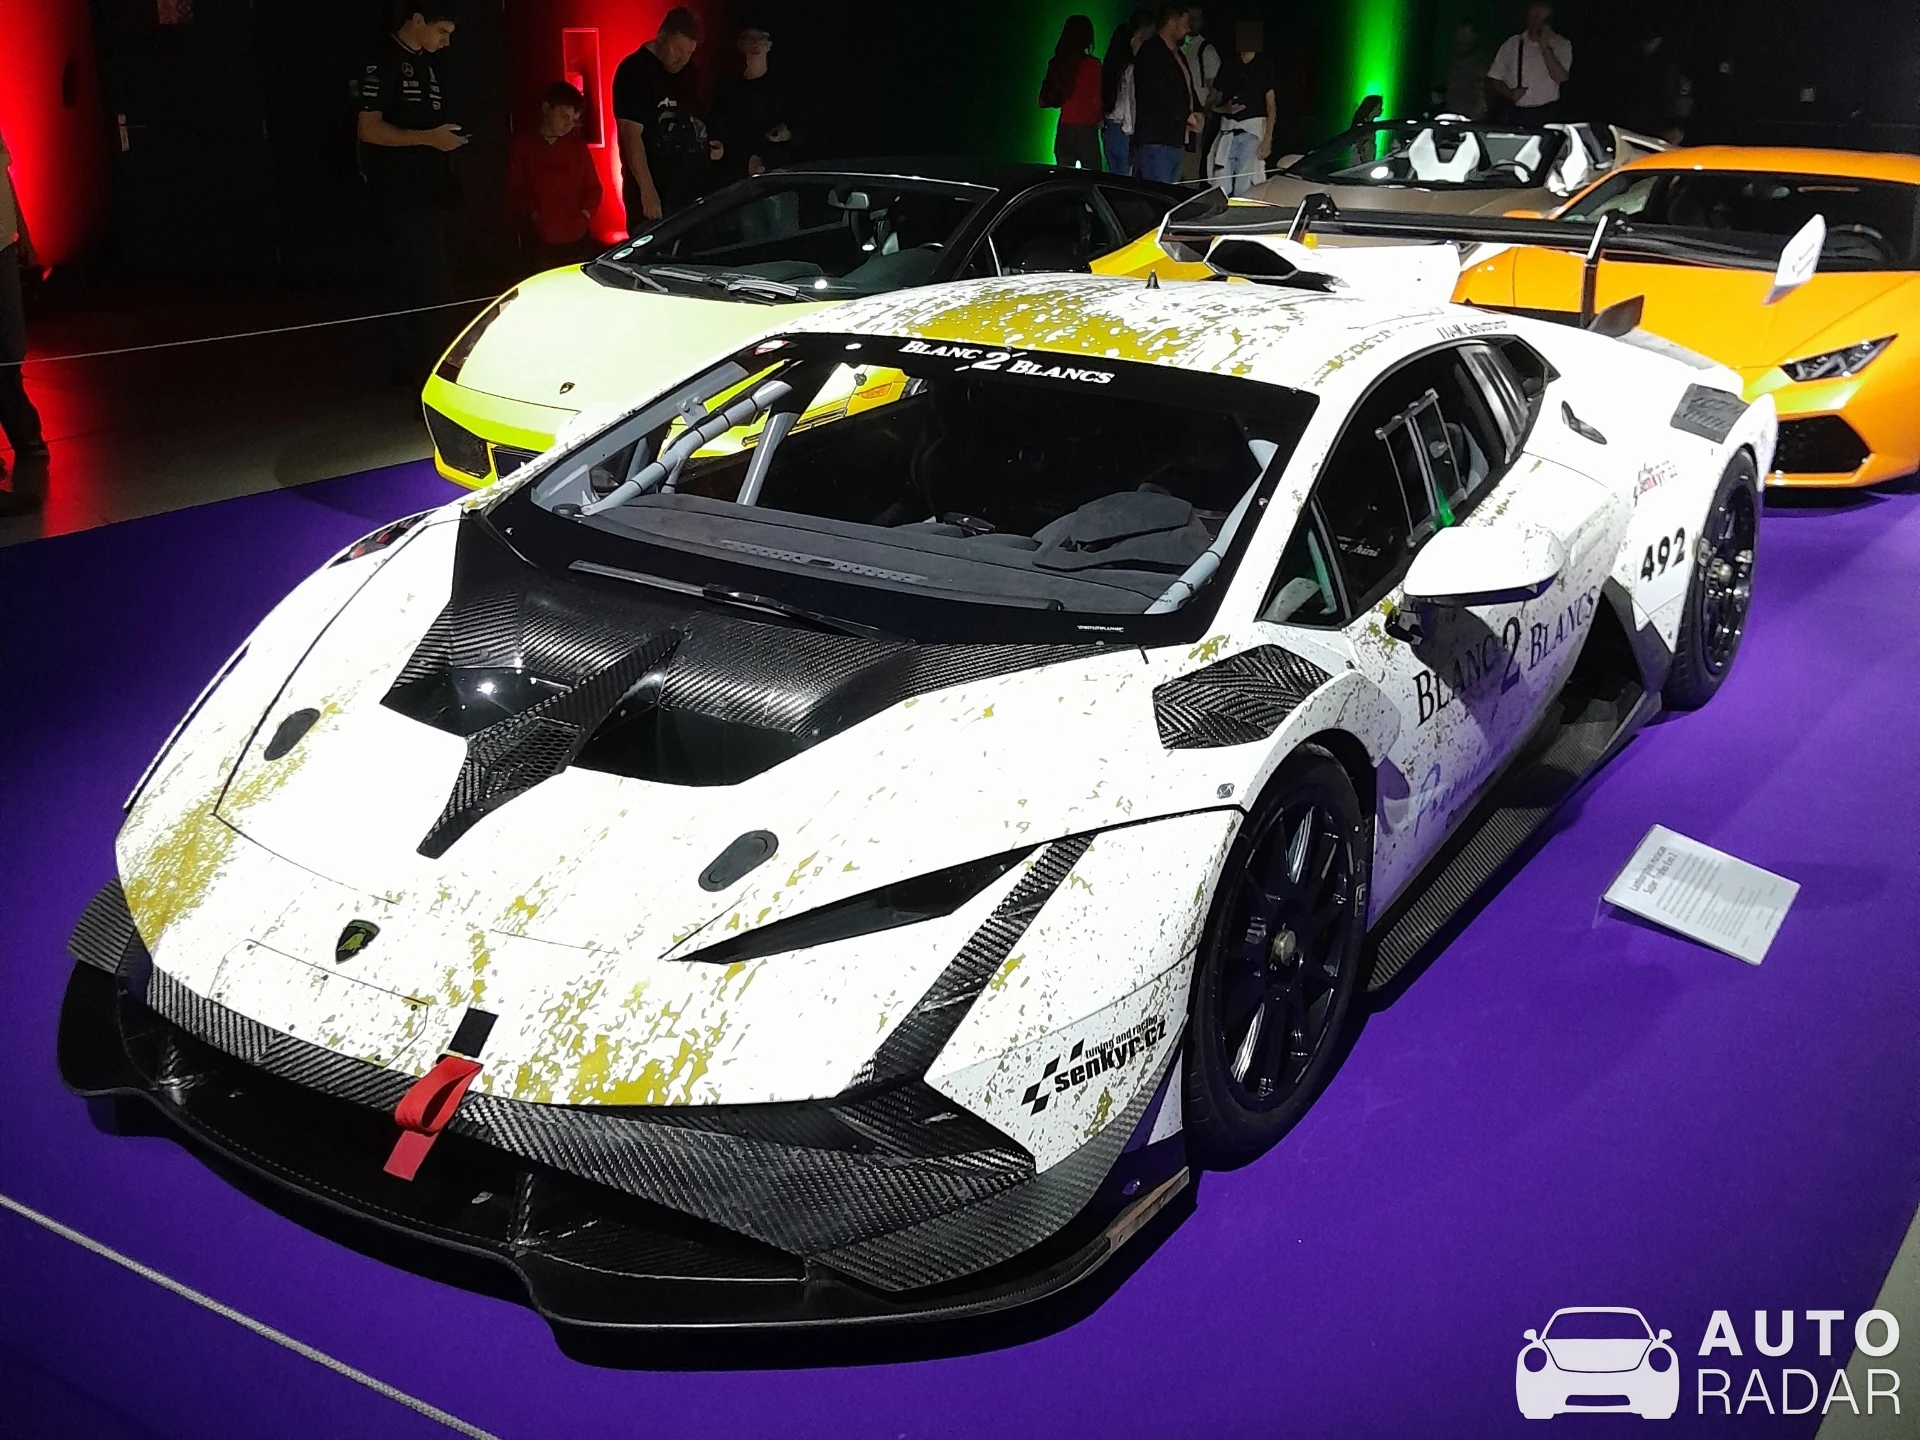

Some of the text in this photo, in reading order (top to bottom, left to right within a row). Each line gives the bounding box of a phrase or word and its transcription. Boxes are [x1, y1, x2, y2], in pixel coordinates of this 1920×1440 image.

[971, 351, 1010, 371] 2
[1640, 527, 1686, 582] 492
[1413, 585, 1597, 727] BLANC 2 BLANCS
[1054, 1019, 1167, 1093] senkyr.cz
[1085, 1014, 1158, 1059] tuning and racing
